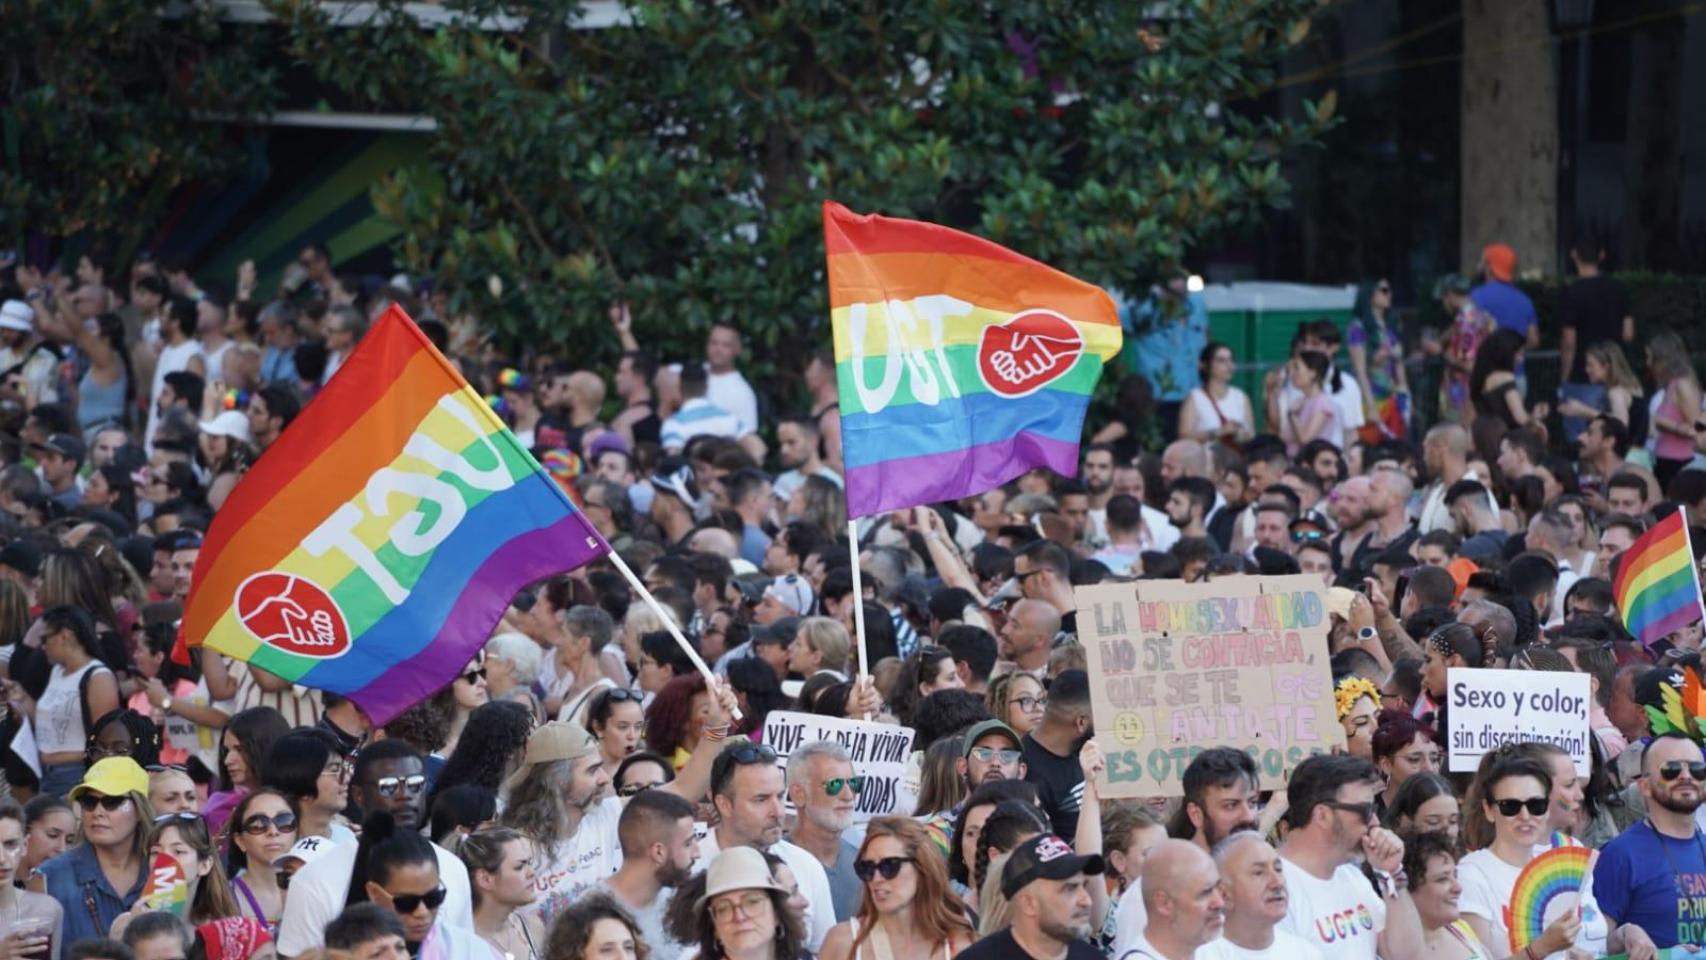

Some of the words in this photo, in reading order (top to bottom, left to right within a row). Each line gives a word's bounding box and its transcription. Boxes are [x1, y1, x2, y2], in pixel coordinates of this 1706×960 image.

[850, 294, 974, 414] UGT
[1094, 602, 1127, 637] LA
[1099, 639, 1136, 673] NO
[1143, 637, 1176, 671] SE
[1105, 675, 1157, 710] QUE
[1164, 671, 1200, 707] SE
[1204, 668, 1242, 705] TE
[1453, 682, 1506, 709] Sexo
[1513, 691, 1525, 717] y
[1530, 687, 1587, 721] color,
[869, 730, 910, 764] VIVIR
[1453, 723, 1475, 749] sin
[1106, 749, 1143, 784] ES
[1315, 908, 1358, 943] UGT
[1677, 897, 1706, 920] PRI
